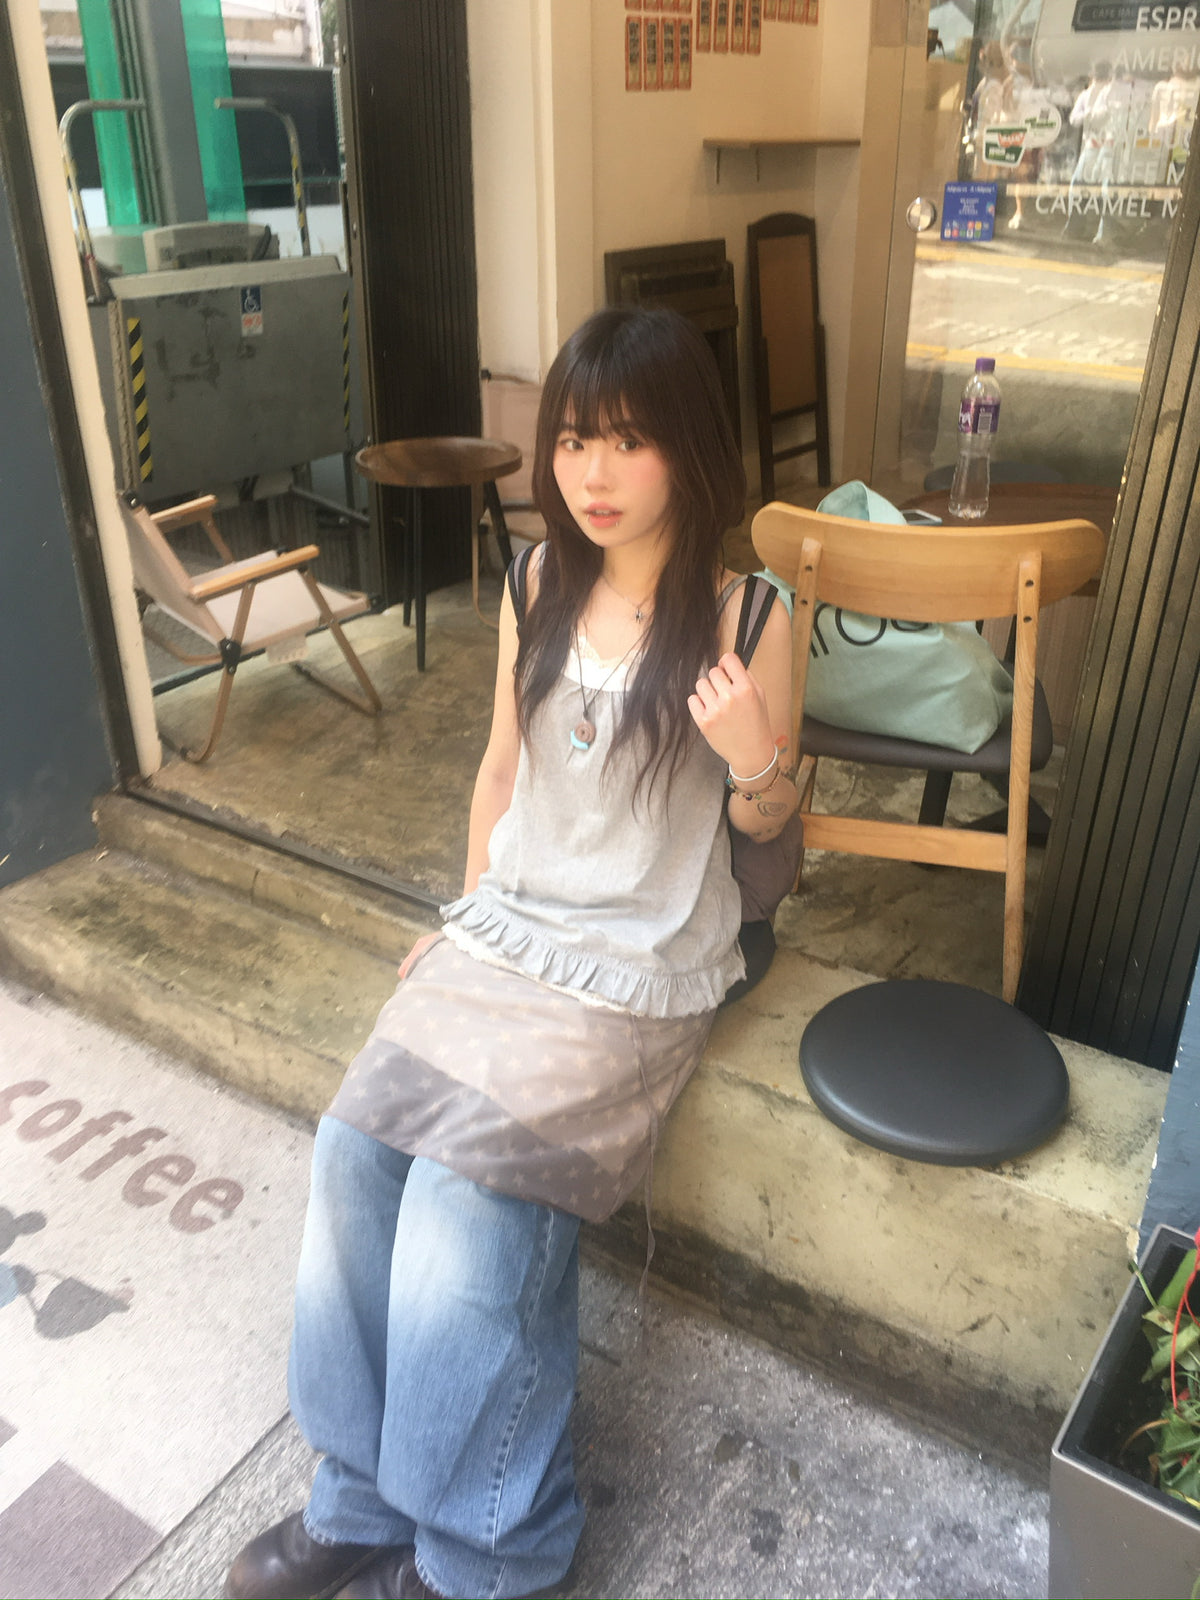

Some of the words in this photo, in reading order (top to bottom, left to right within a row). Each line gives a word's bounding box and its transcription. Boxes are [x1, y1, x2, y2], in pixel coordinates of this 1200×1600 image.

[1136, 6, 1198, 32] ESPR
[1113, 45, 1200, 72] AMERI
[1035, 193, 1151, 218] CARAMEL
[0, 1079, 245, 1234] coffee
